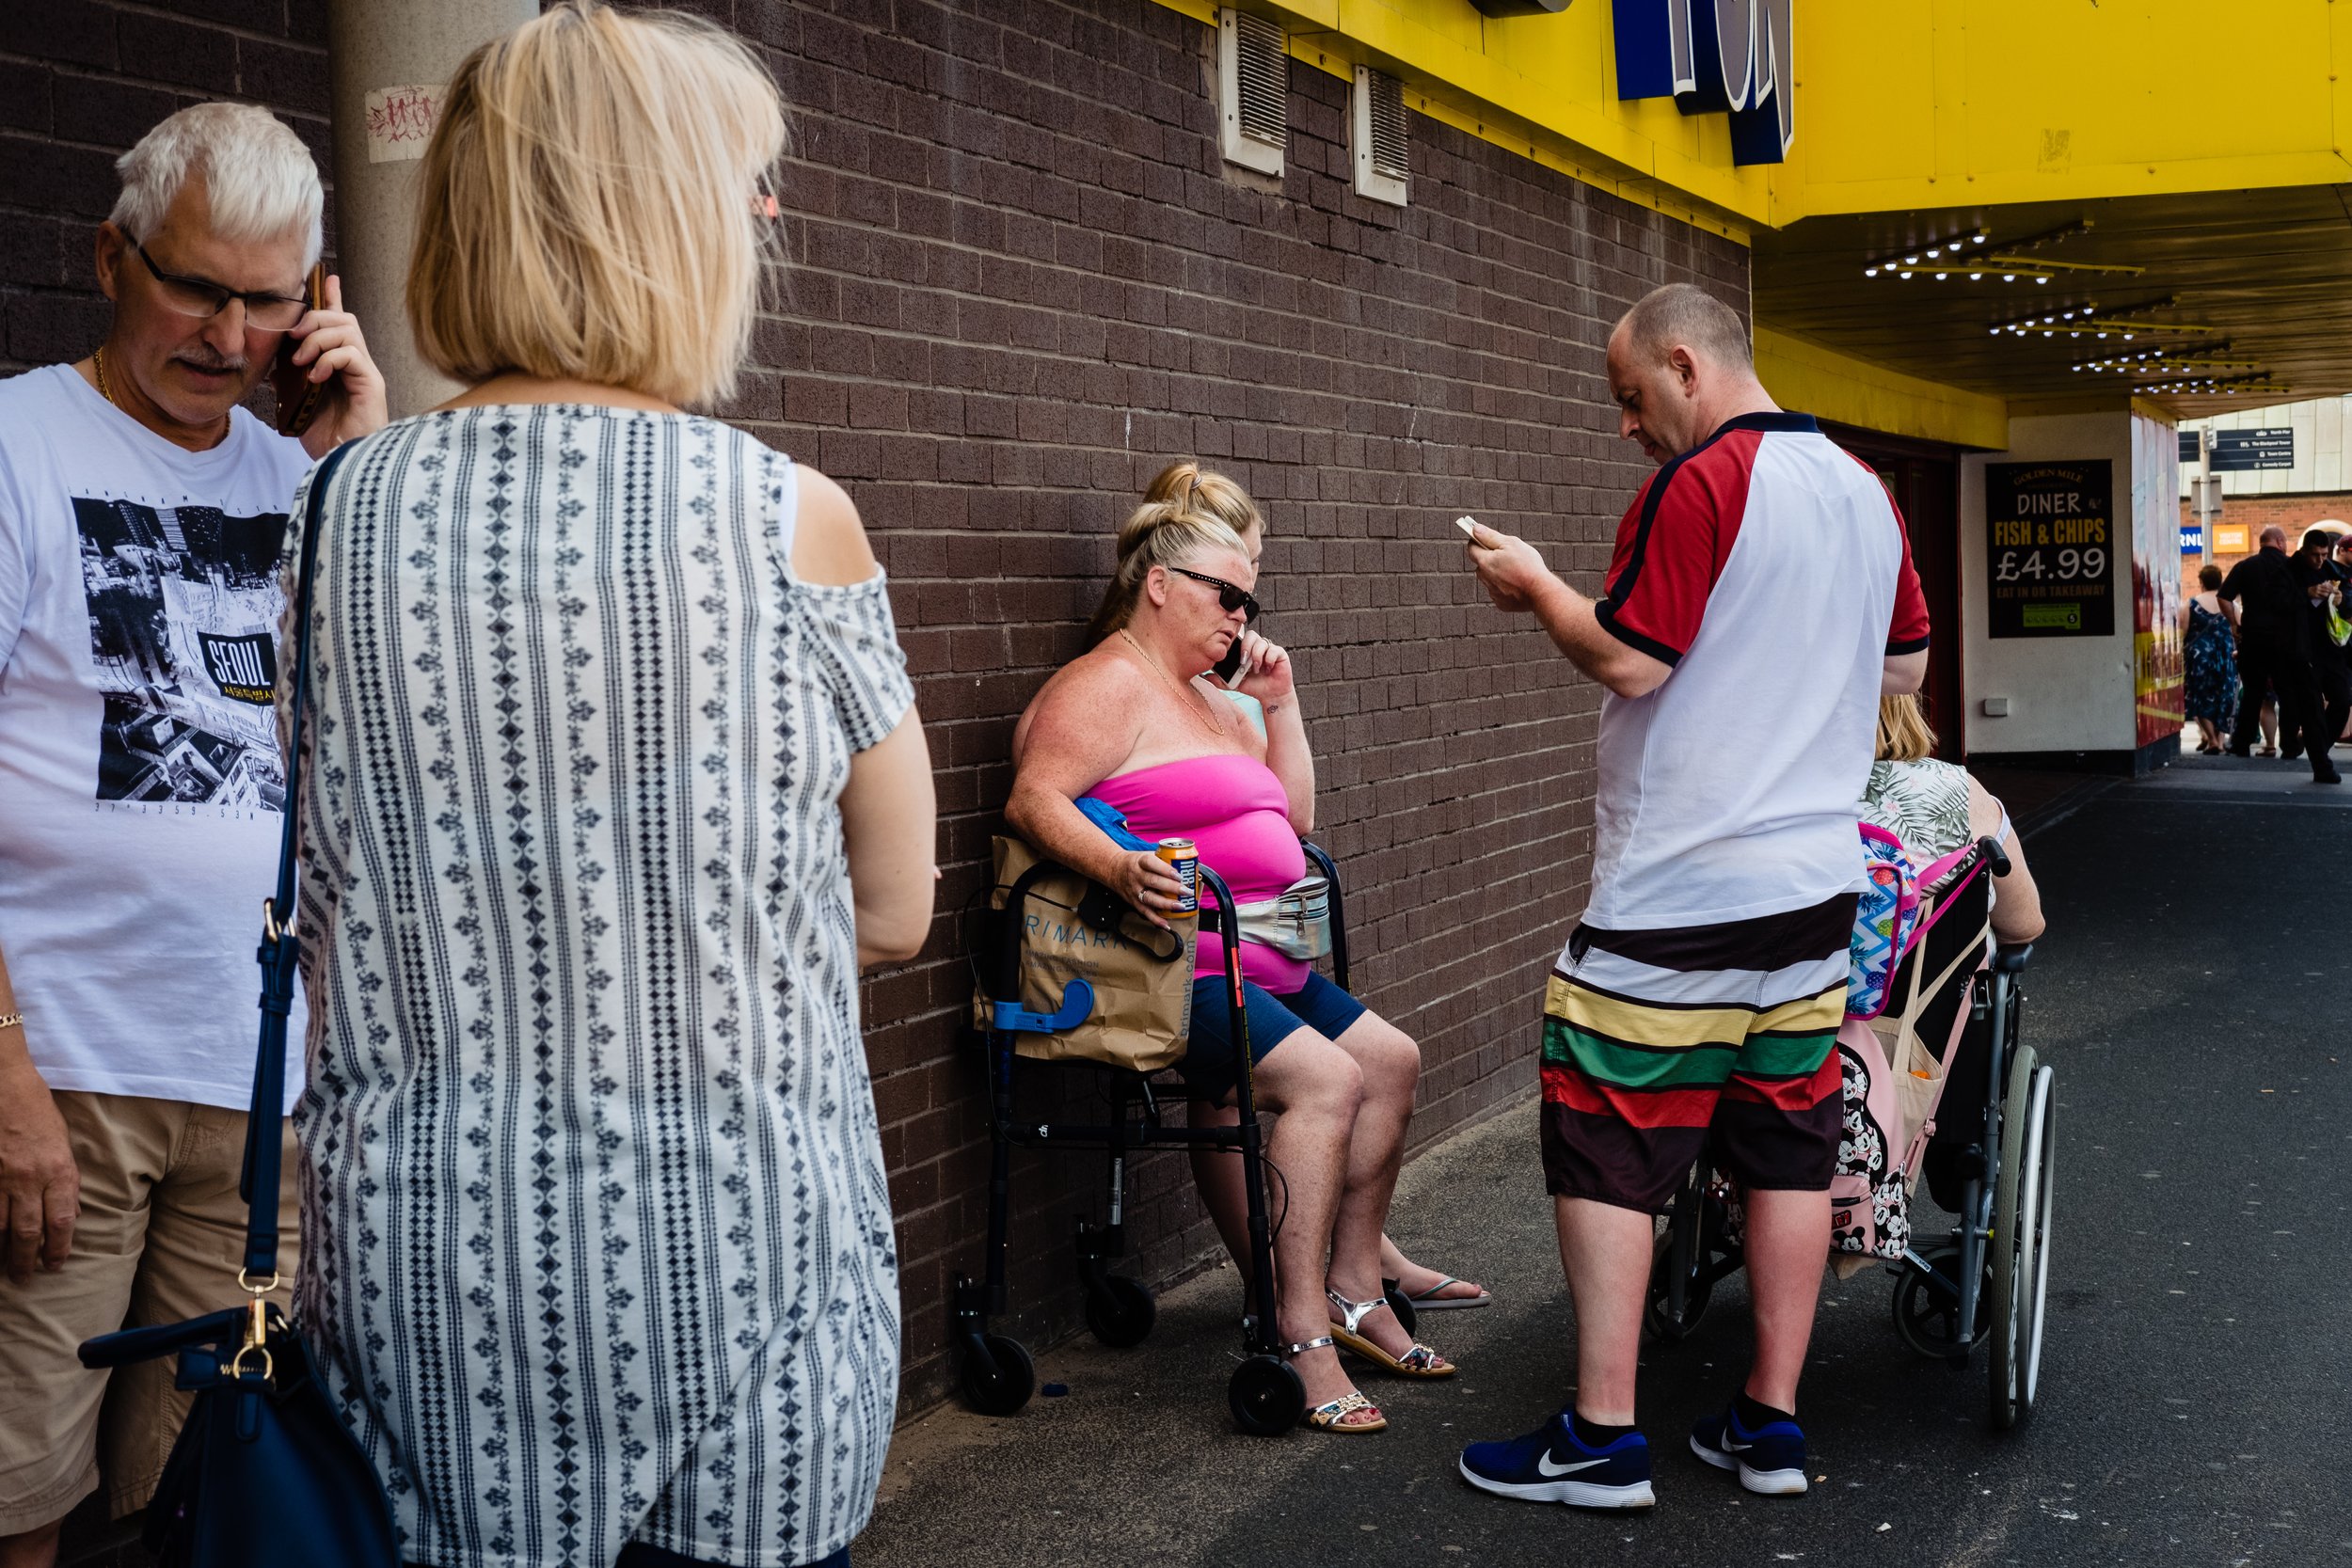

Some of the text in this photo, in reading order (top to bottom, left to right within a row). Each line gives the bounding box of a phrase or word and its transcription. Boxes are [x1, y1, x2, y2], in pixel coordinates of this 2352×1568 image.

[2013, 468, 2055, 485] GOLDEN
[2057, 469, 2084, 483] MILE
[2017, 492, 2082, 515] DINER
[1994, 517, 2106, 546] FISH & CHIPS
[1995, 547, 2106, 581] £4.99
[1996, 584, 2106, 598] EAT IN OR TAKEAWAY
[208, 640, 271, 687] SEOUL
[1180, 940, 1196, 1038] primark.com
